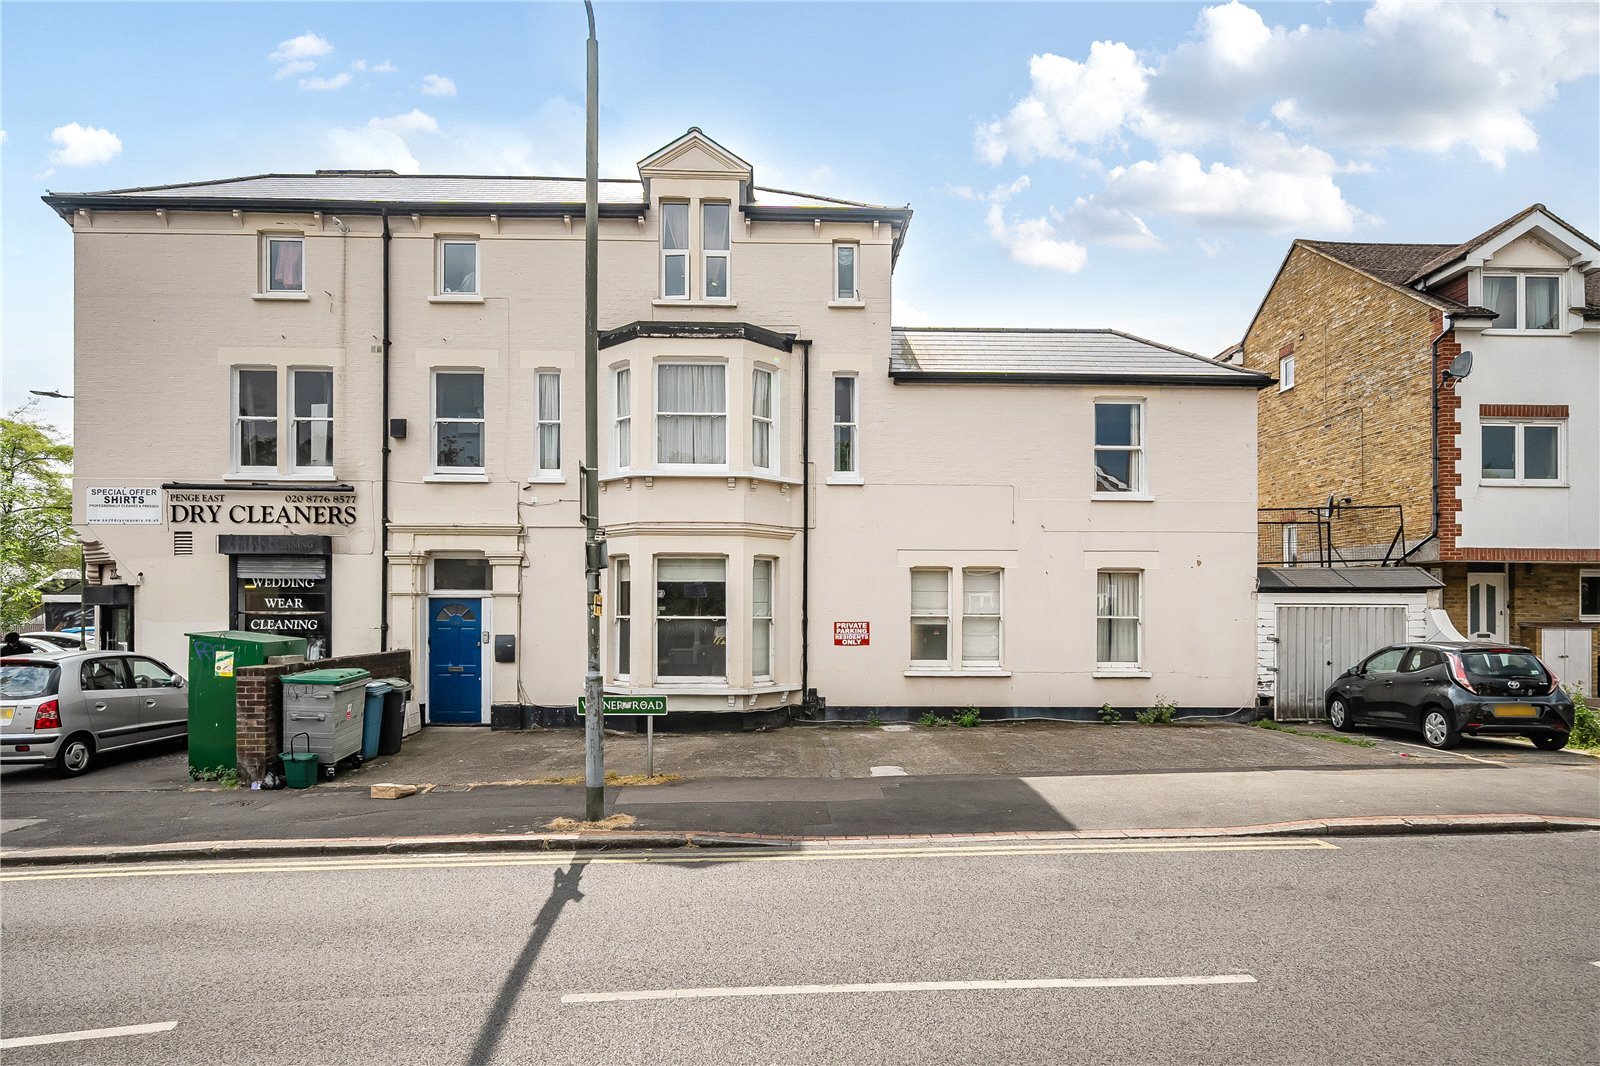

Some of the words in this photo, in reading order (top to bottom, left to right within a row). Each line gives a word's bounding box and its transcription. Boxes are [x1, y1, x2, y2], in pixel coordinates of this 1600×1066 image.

[104, 496, 145, 504] SHIRTS
[170, 494, 200, 502] PENGE
[201, 494, 225, 502] EAST
[285, 495, 304, 503] 020
[306, 495, 330, 503] 8776
[332, 495, 357, 503] 8577
[170, 505, 222, 523] DRY
[229, 505, 357, 524] CLEANERS
[252, 578, 315, 588] WEDDING
[264, 598, 303, 608] WEAR
[250, 619, 318, 630] CLEANING
[632, 701, 663, 710] ROAD
